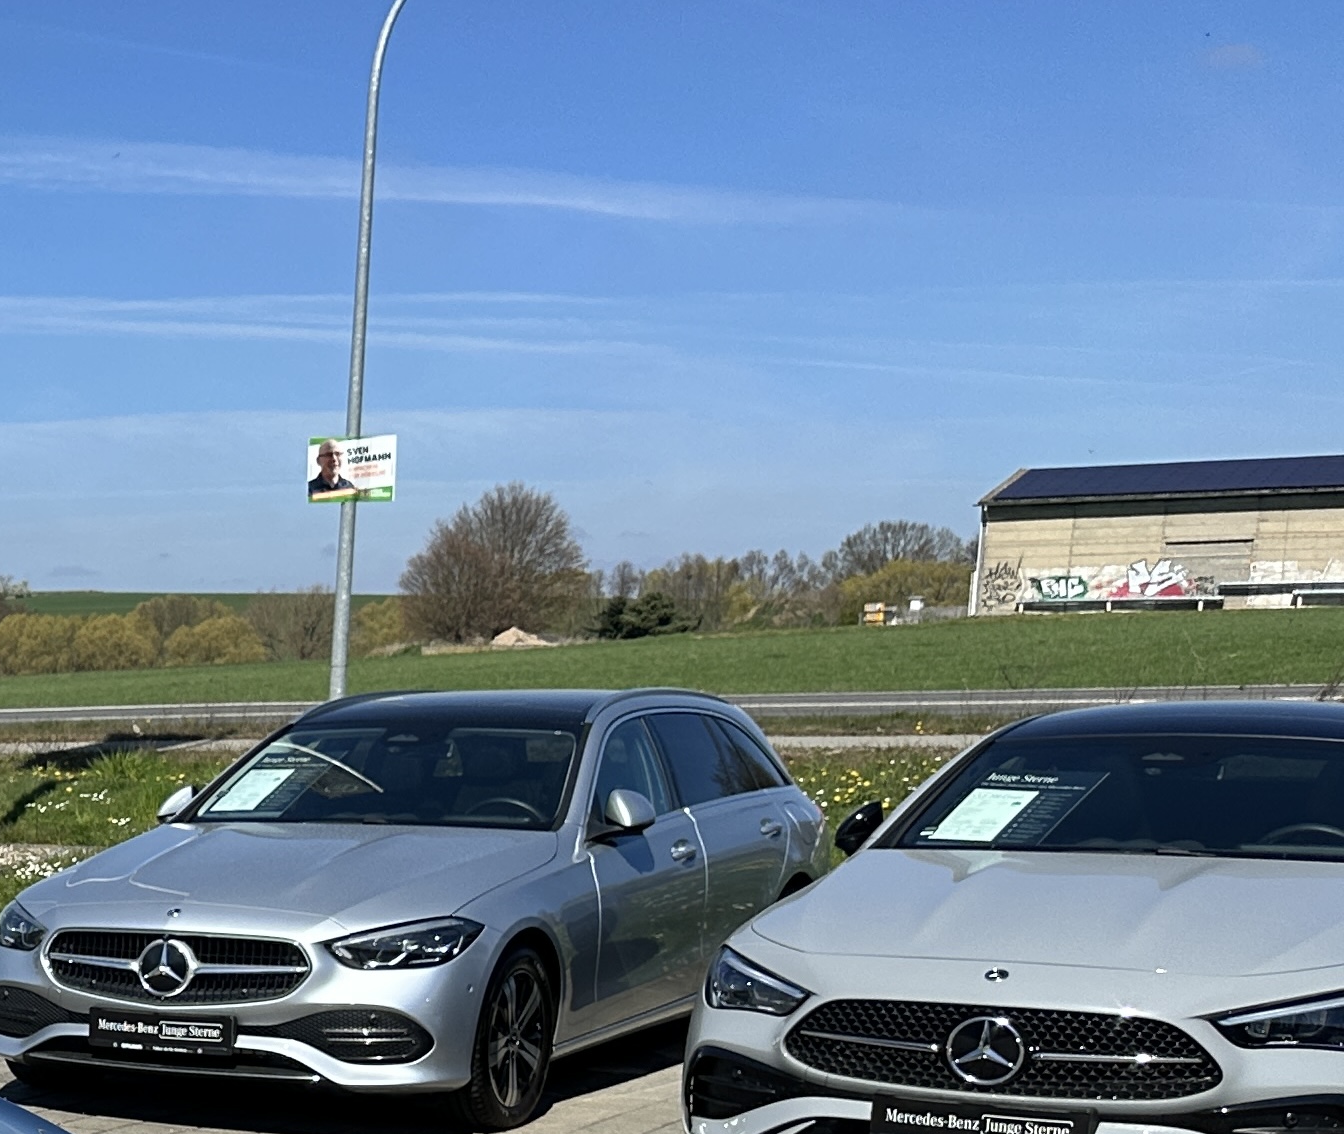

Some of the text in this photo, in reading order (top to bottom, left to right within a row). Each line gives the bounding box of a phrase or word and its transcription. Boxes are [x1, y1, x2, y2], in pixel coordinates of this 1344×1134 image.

[347, 446, 368, 456] SVEN
[97, 1018, 220, 1038] Mercedes-Benz Junge Sterne
[884, 1107, 980, 1131] Mercedes-Benz
